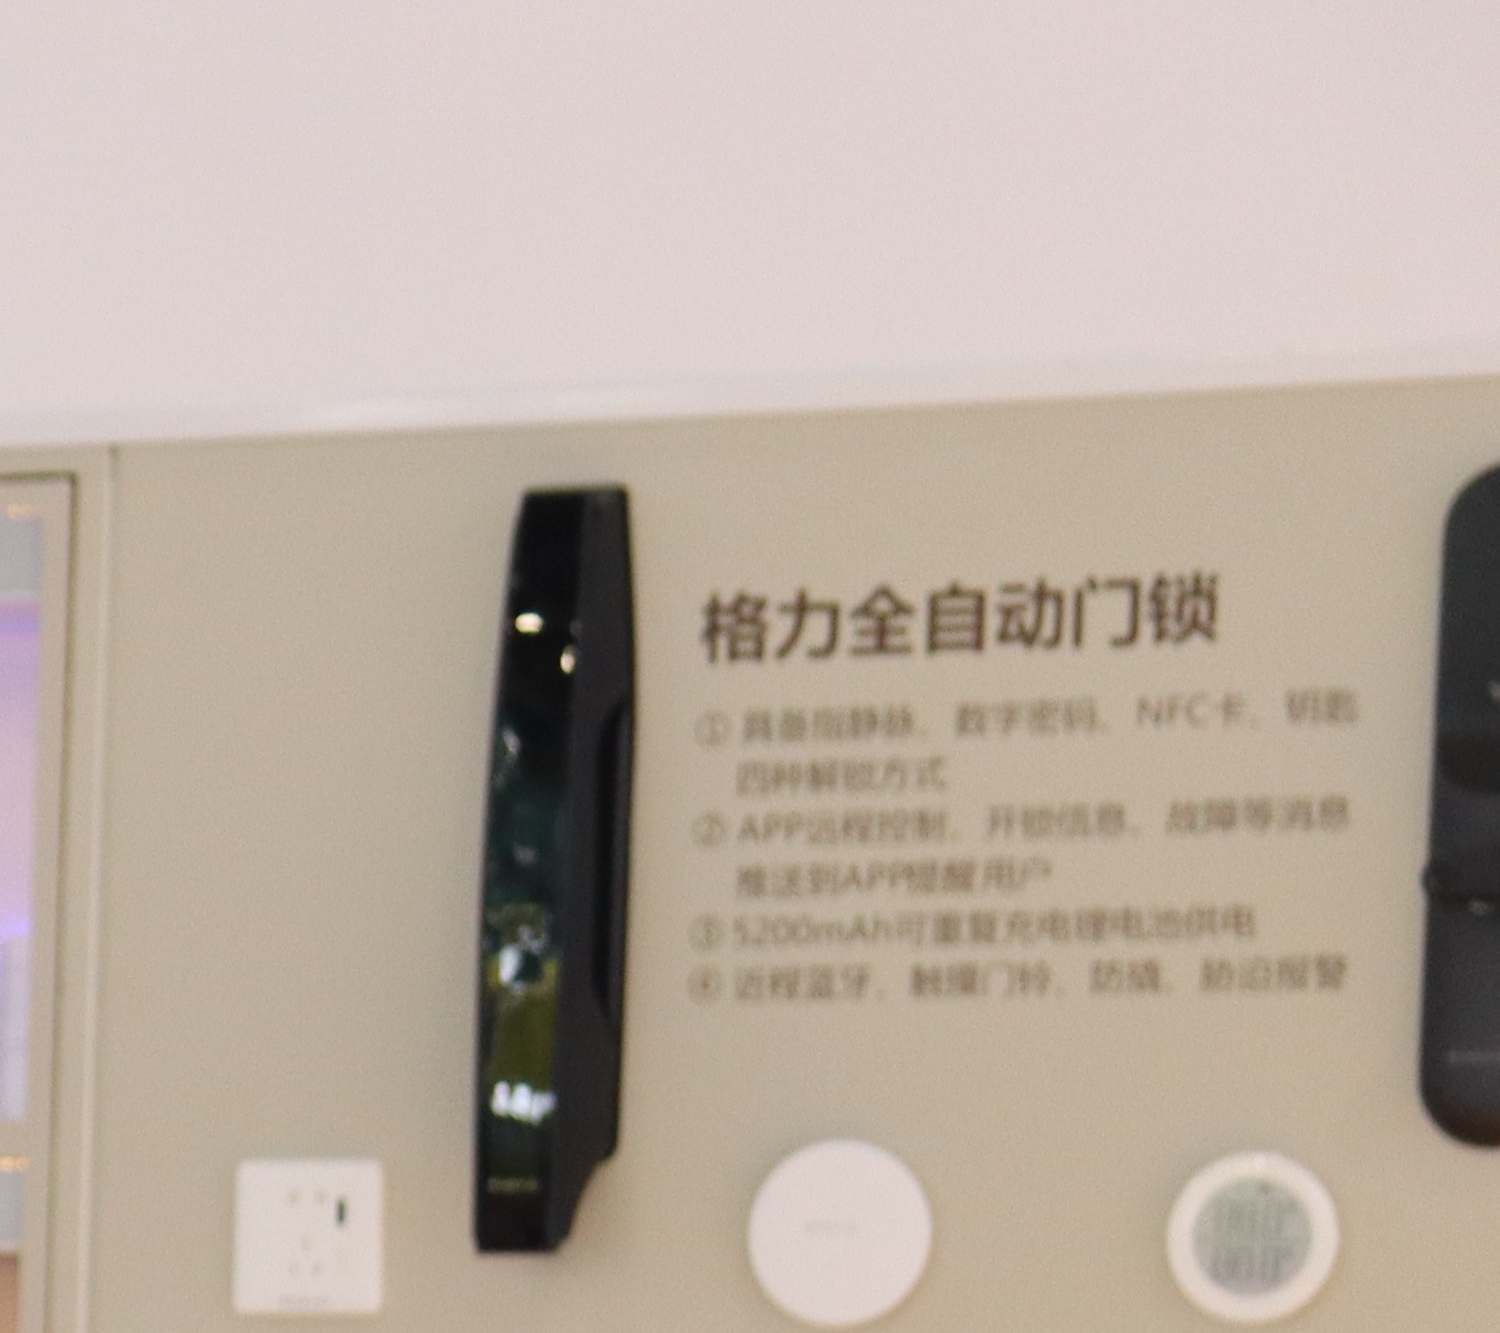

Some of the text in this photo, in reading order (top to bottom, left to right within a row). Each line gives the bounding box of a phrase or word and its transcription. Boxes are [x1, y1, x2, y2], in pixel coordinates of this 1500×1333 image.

[700, 570, 1221, 665] 格力全自动门锁
